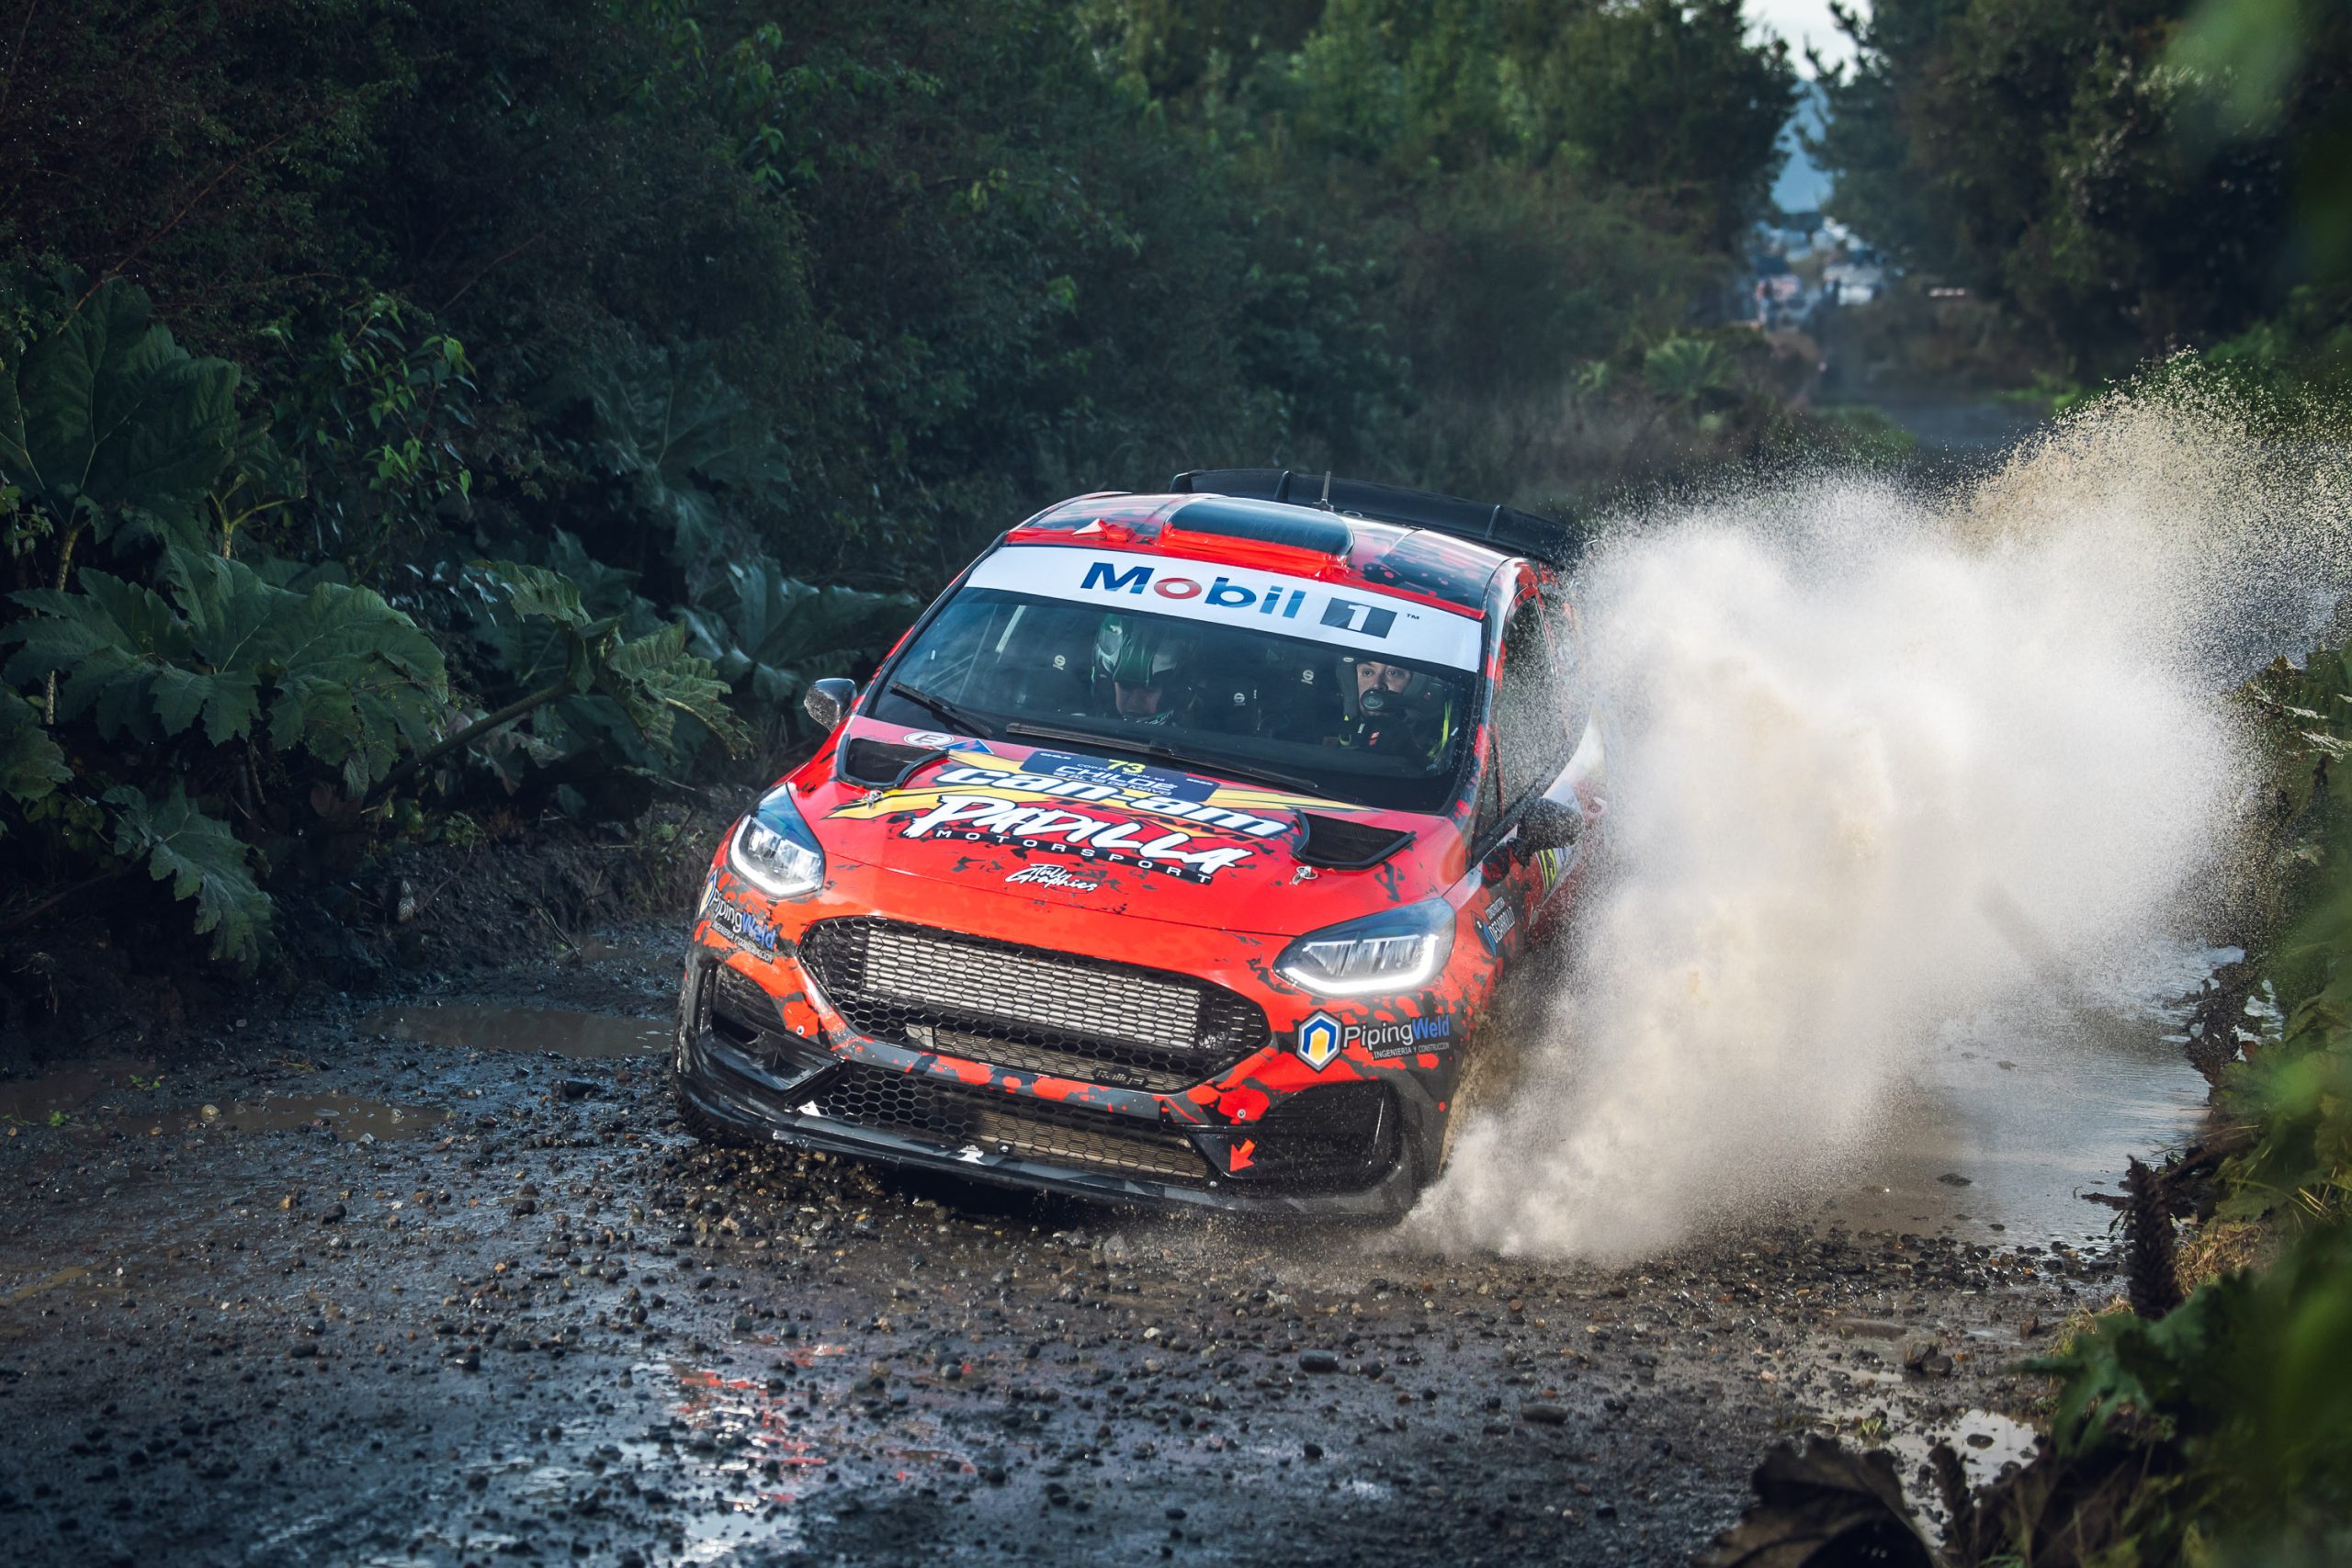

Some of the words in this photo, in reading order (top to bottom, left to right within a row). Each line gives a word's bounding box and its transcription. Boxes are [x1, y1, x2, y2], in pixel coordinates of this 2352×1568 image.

[1080, 561, 1306, 619] Mobil
[1108, 758, 1147, 773] 73
[903, 794, 1254, 874] PADILLA
[935, 829, 1213, 885] MOTORSPORT
[709, 887, 776, 951] PipingWeld
[1342, 1015, 1451, 1051] PipingWeld
[1374, 1047, 1413, 1059] INGENIERIA
